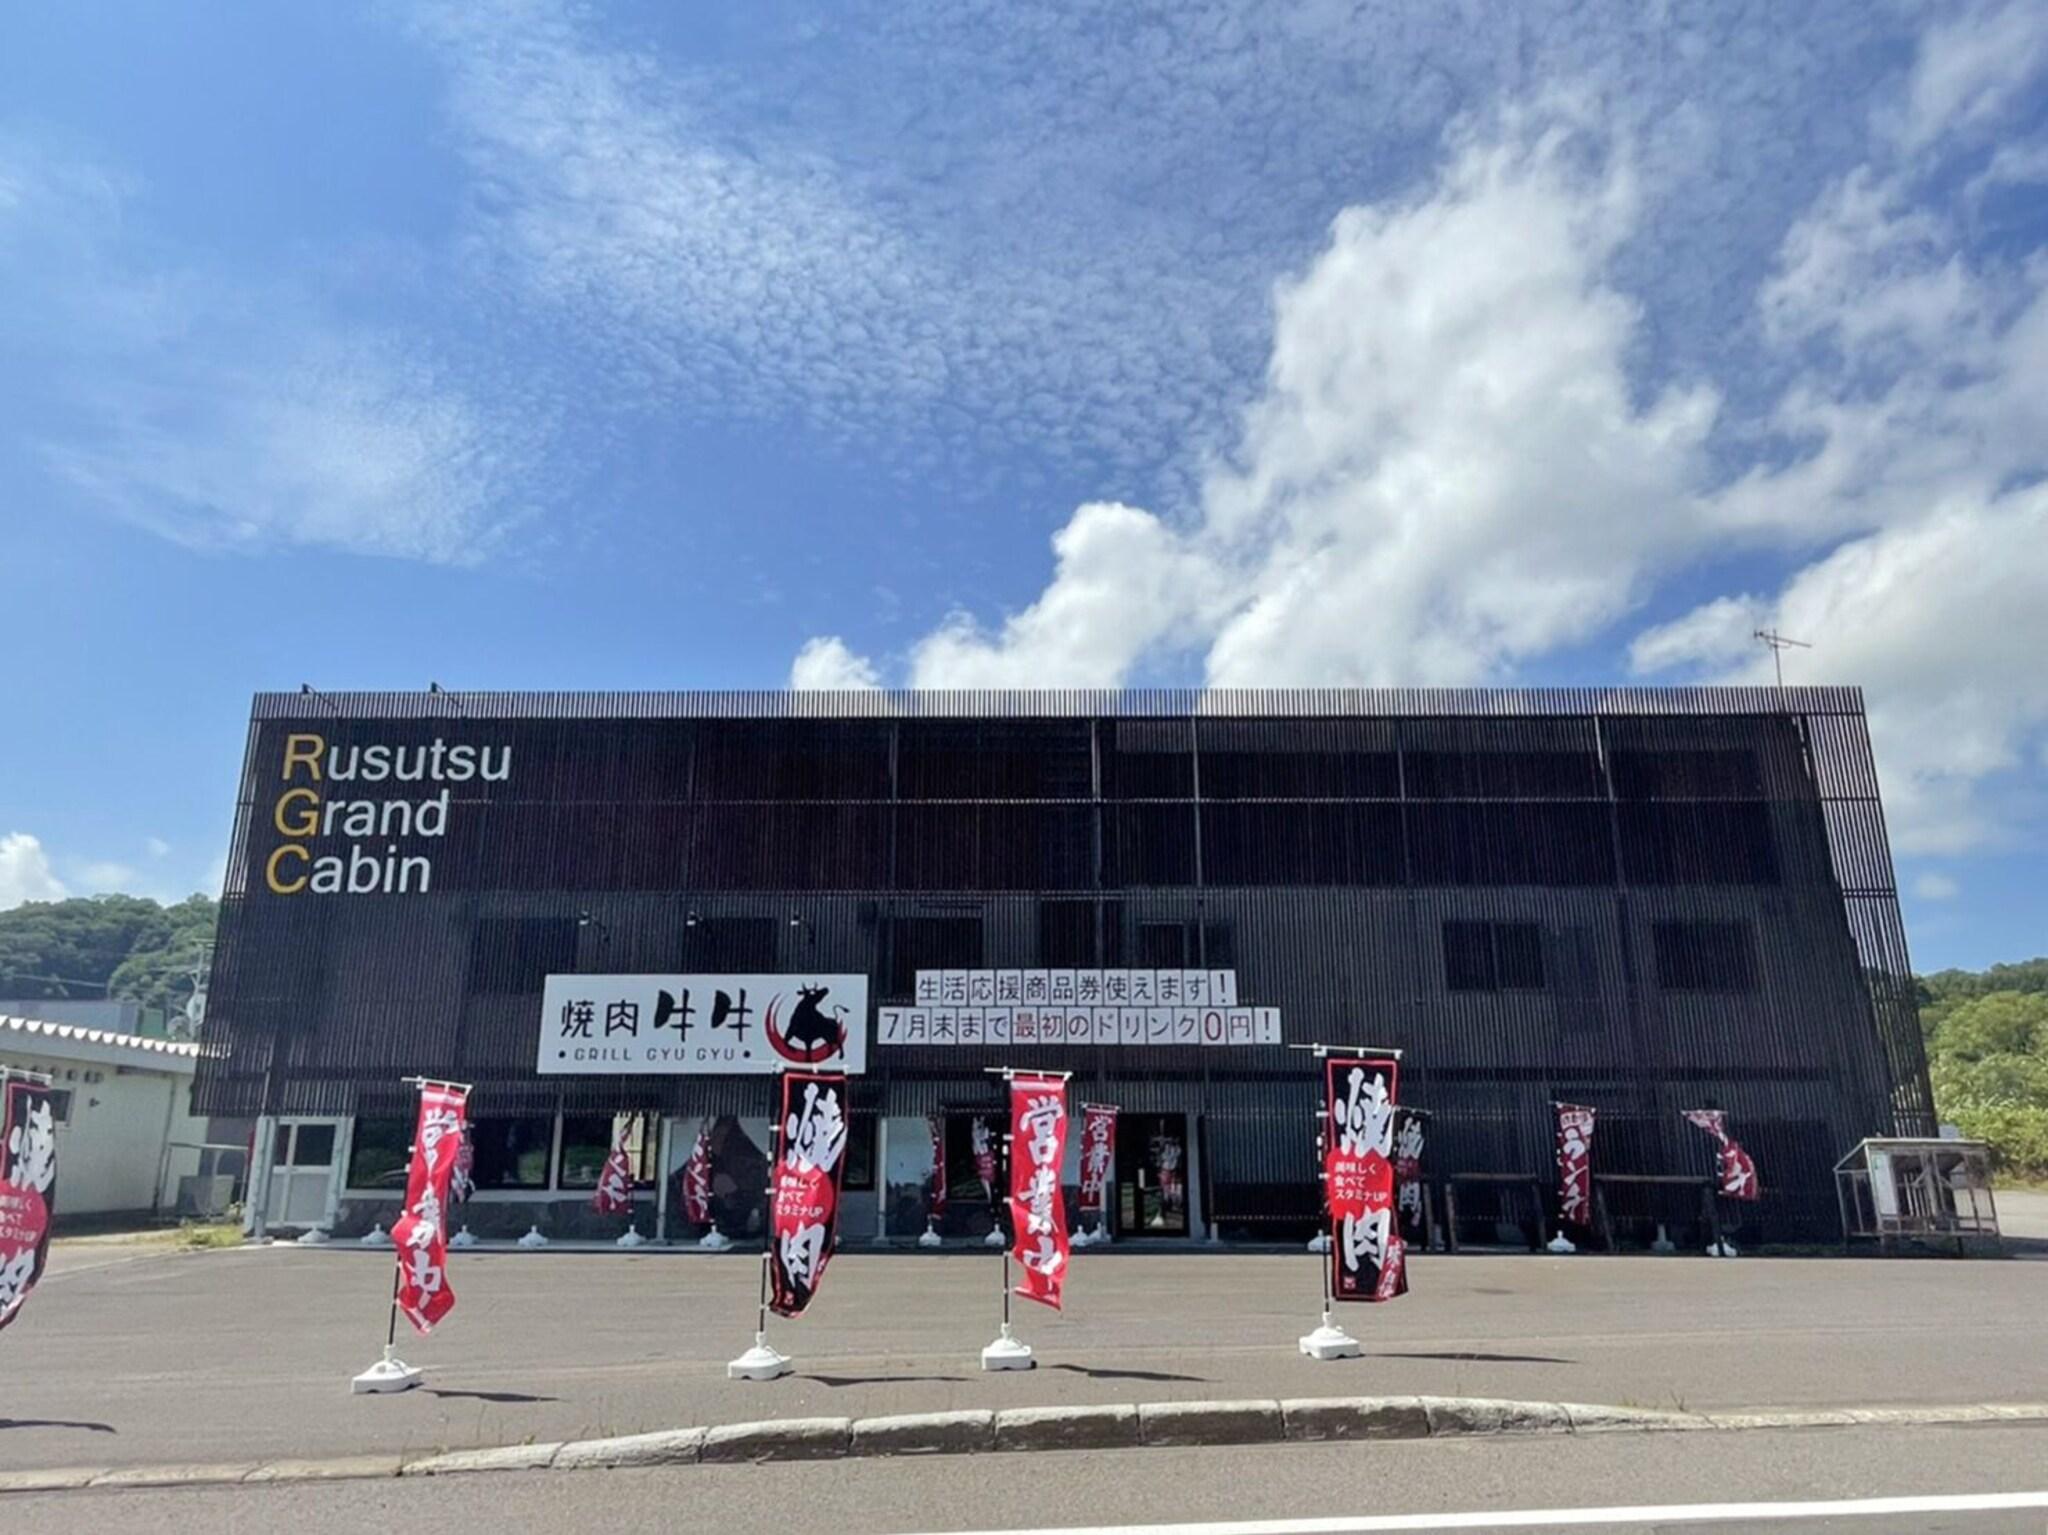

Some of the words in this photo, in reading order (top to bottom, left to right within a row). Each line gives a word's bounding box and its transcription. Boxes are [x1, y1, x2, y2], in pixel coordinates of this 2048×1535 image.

[281, 733, 512, 782] Rusutsu
[274, 788, 450, 836] Grand
[265, 844, 431, 894] Cabin
[561, 999, 640, 1039] 焼肉
[574, 1047, 632, 1061] GRILL
[646, 1047, 685, 1061] GYU
[696, 1047, 735, 1061] GYU
